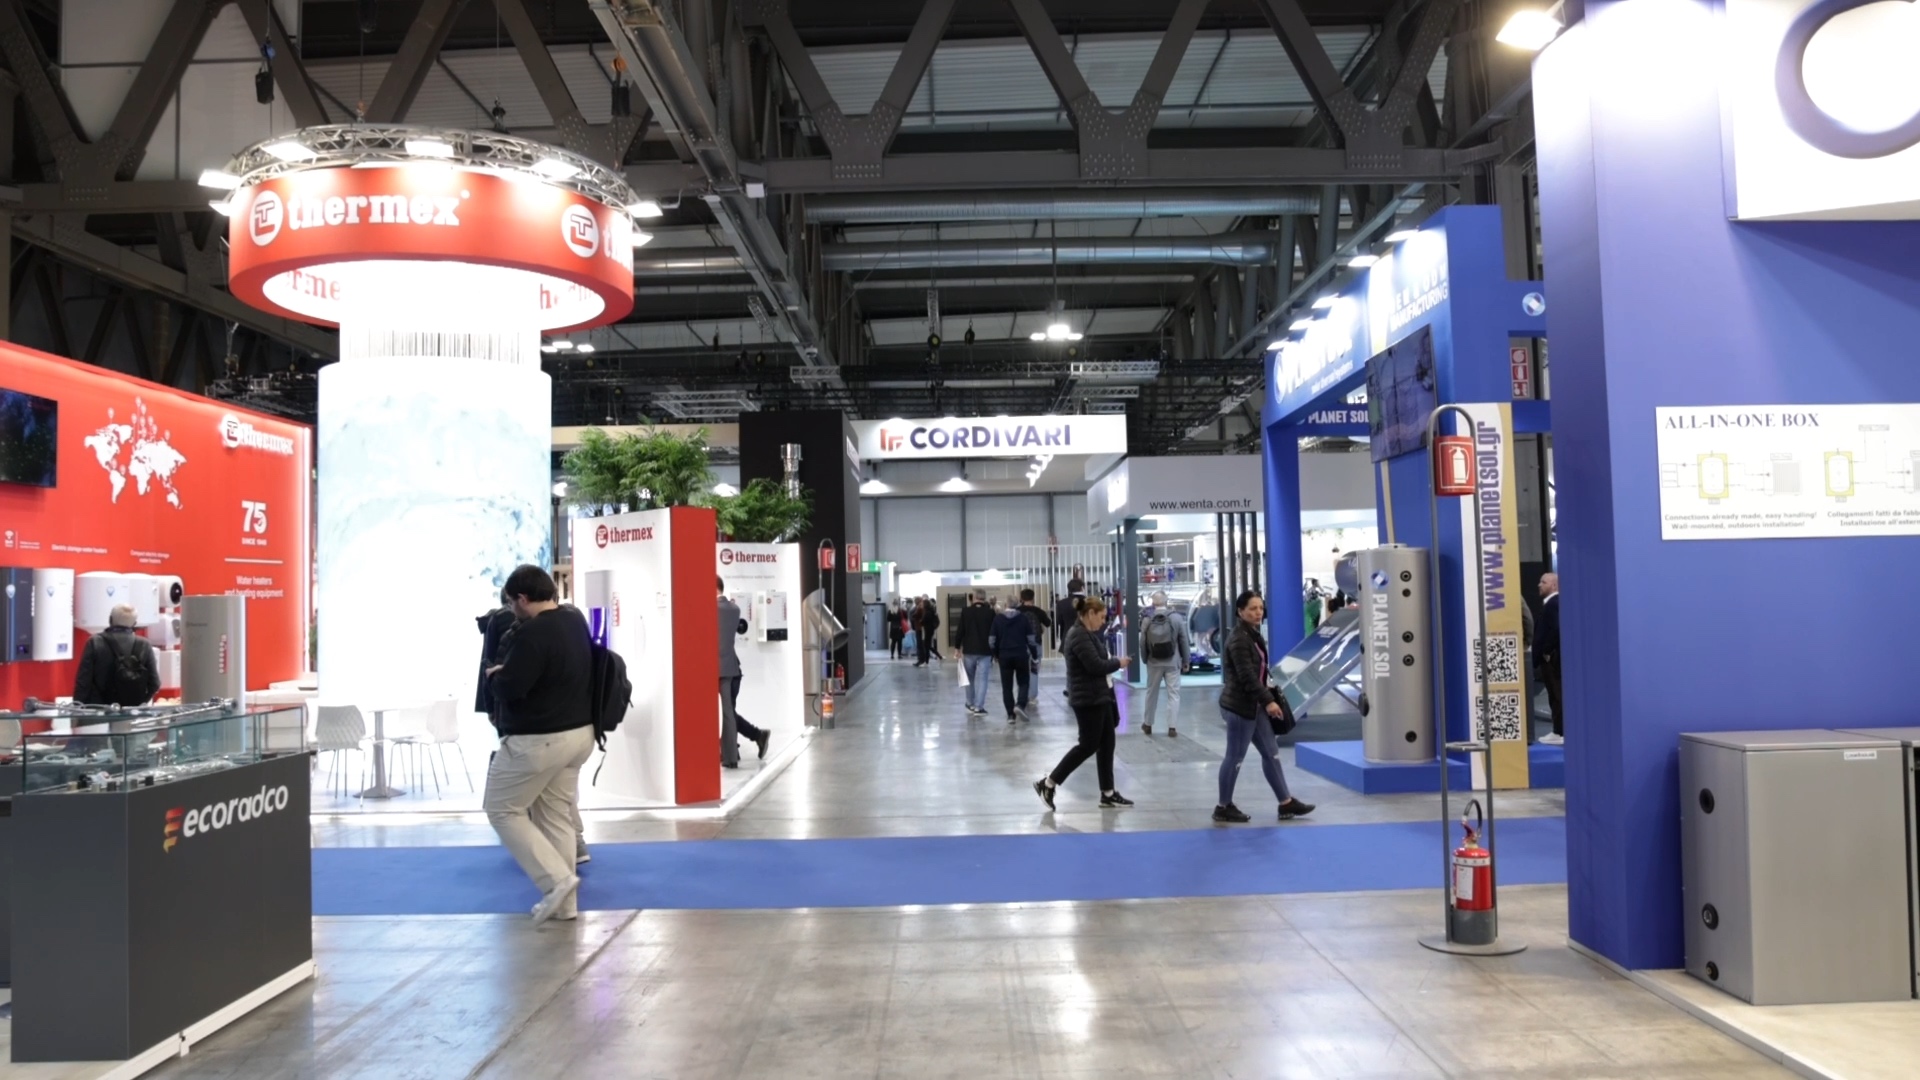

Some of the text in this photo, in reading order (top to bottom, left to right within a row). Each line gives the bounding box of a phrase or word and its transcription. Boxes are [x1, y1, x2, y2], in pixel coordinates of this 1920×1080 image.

[287, 191, 460, 231] thermex
[1391, 281, 1448, 332] MANUFACTURING
[1308, 410, 1369, 424] PLANET SOL
[1665, 412, 1820, 430] ALL-IN-ONE BOX
[910, 424, 1071, 450] CORDIVARI
[1149, 498, 1252, 510] www.wenta.com.tr
[242, 500, 267, 534] 75
[1477, 421, 1506, 611] www.planetsol.gr
[1664, 512, 1710, 521] Connections
[1712, 512, 1739, 521] already
[1741, 512, 1763, 520] made,
[1765, 513, 1782, 521] easy
[1827, 510, 1874, 519] Collegamenti
[1892, 509, 1902, 517] da
[1728, 521, 1760, 530] outdoors
[1840, 519, 1886, 527] Installazione
[610, 526, 654, 543] thermex
[735, 551, 777, 563] thermex
[256, 588, 284, 599] equipment
[1372, 593, 1390, 679] PLANET SOL
[183, 785, 289, 838] ecoradco
